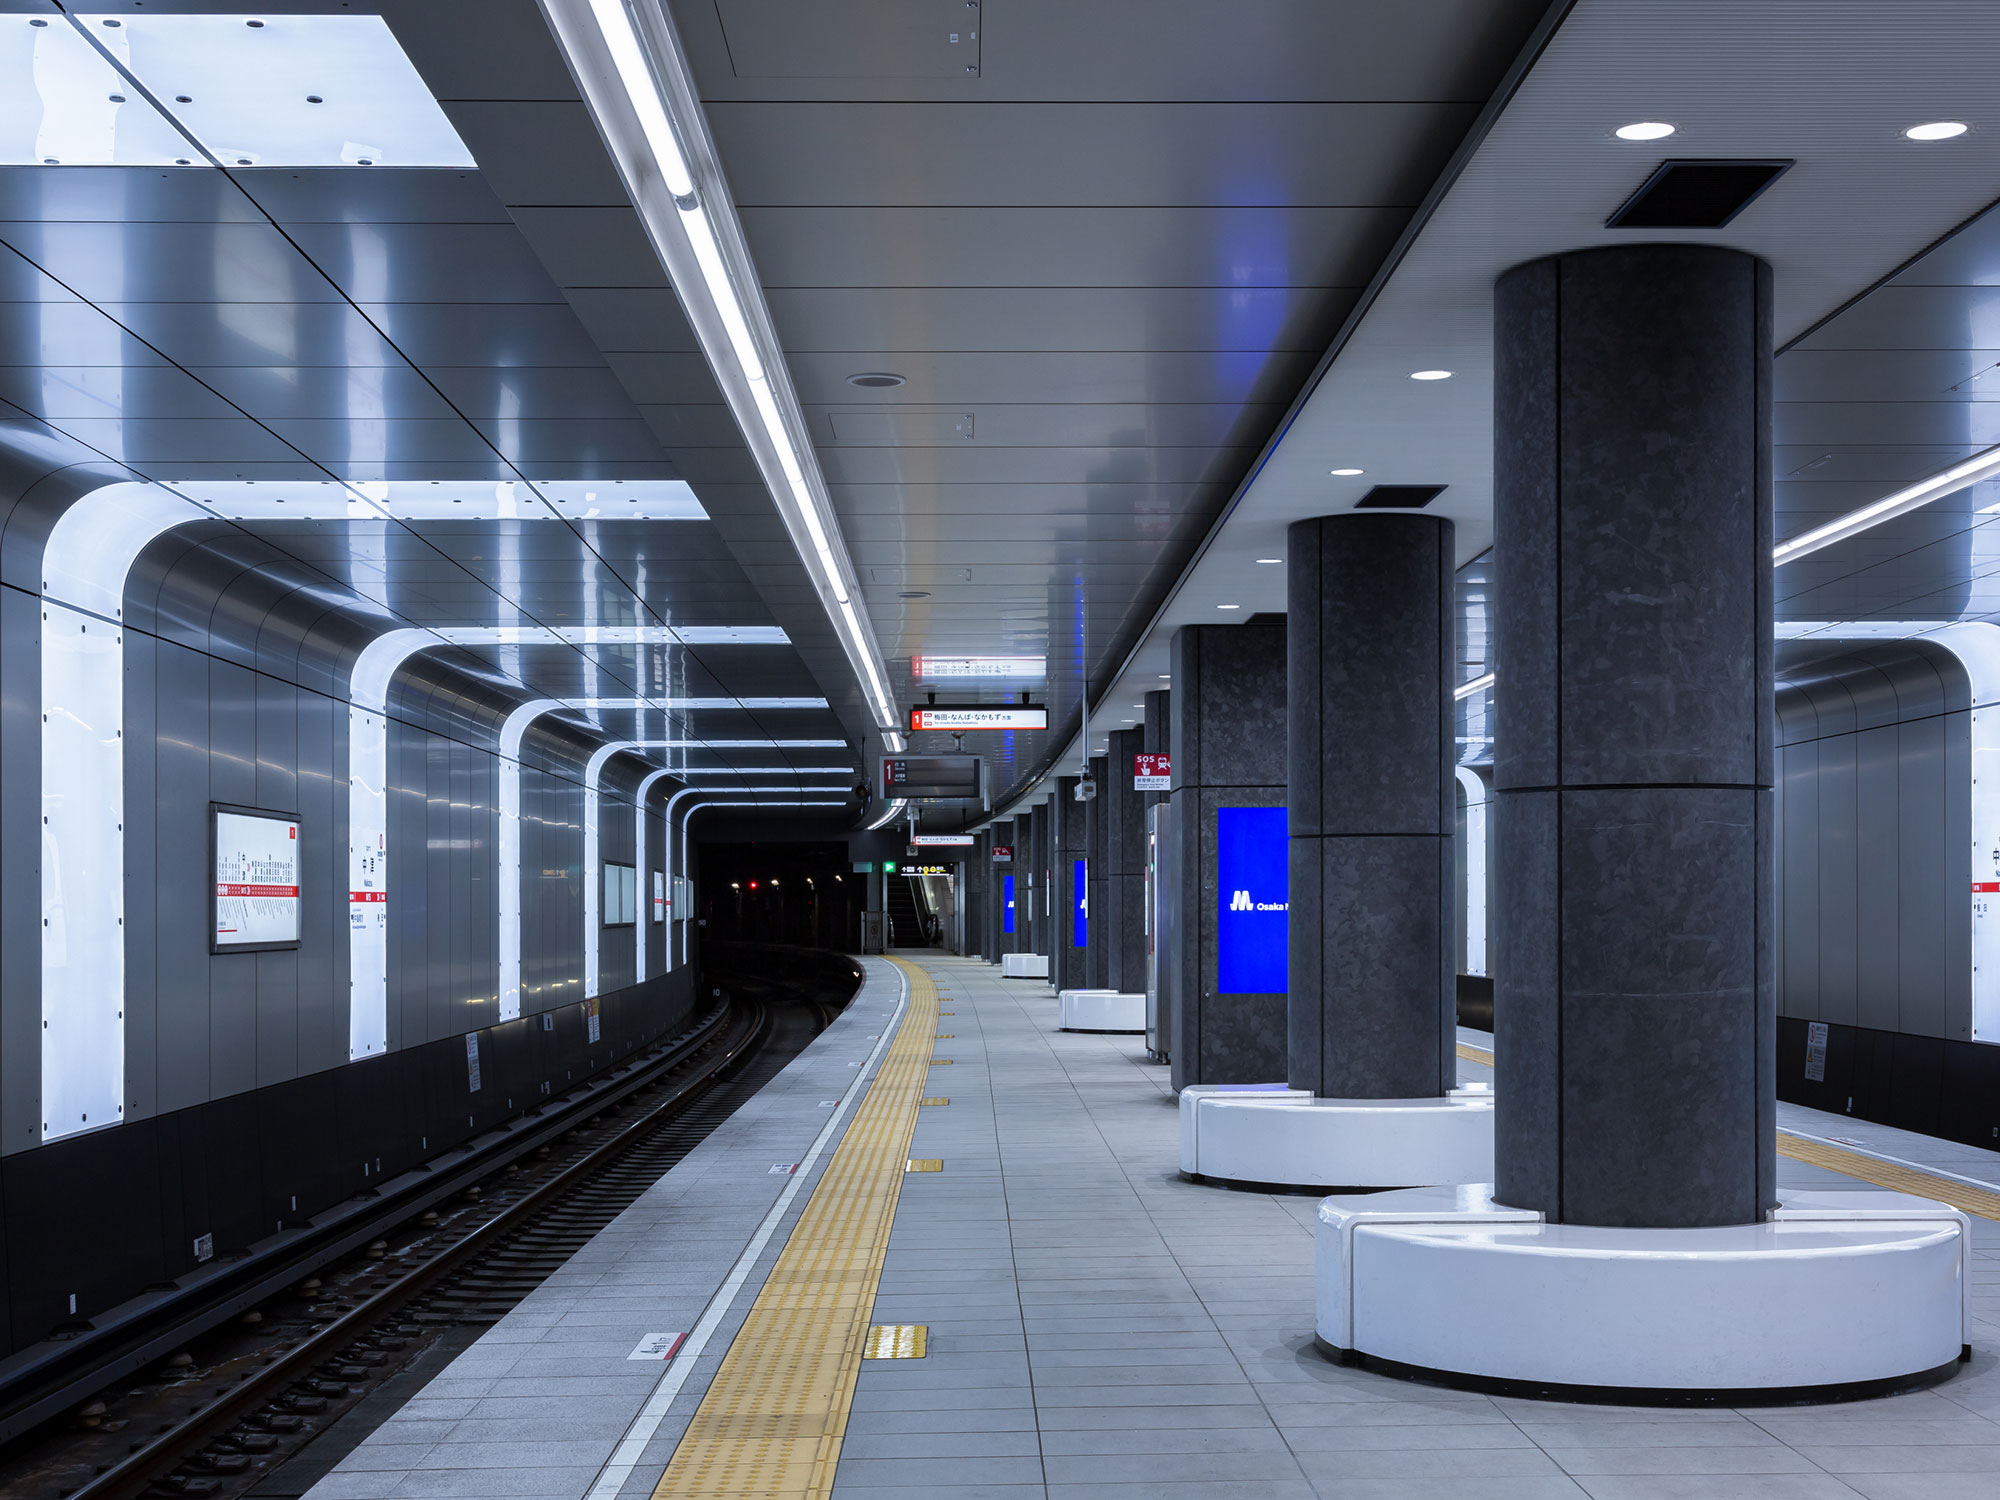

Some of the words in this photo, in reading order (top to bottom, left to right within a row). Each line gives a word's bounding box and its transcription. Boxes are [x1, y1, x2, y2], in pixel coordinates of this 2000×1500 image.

[914, 714, 920, 724] 1
[1136, 755, 1155, 763] SOS
[886, 763, 892, 780] 1
[1256, 902, 1284, 911] Osaka
